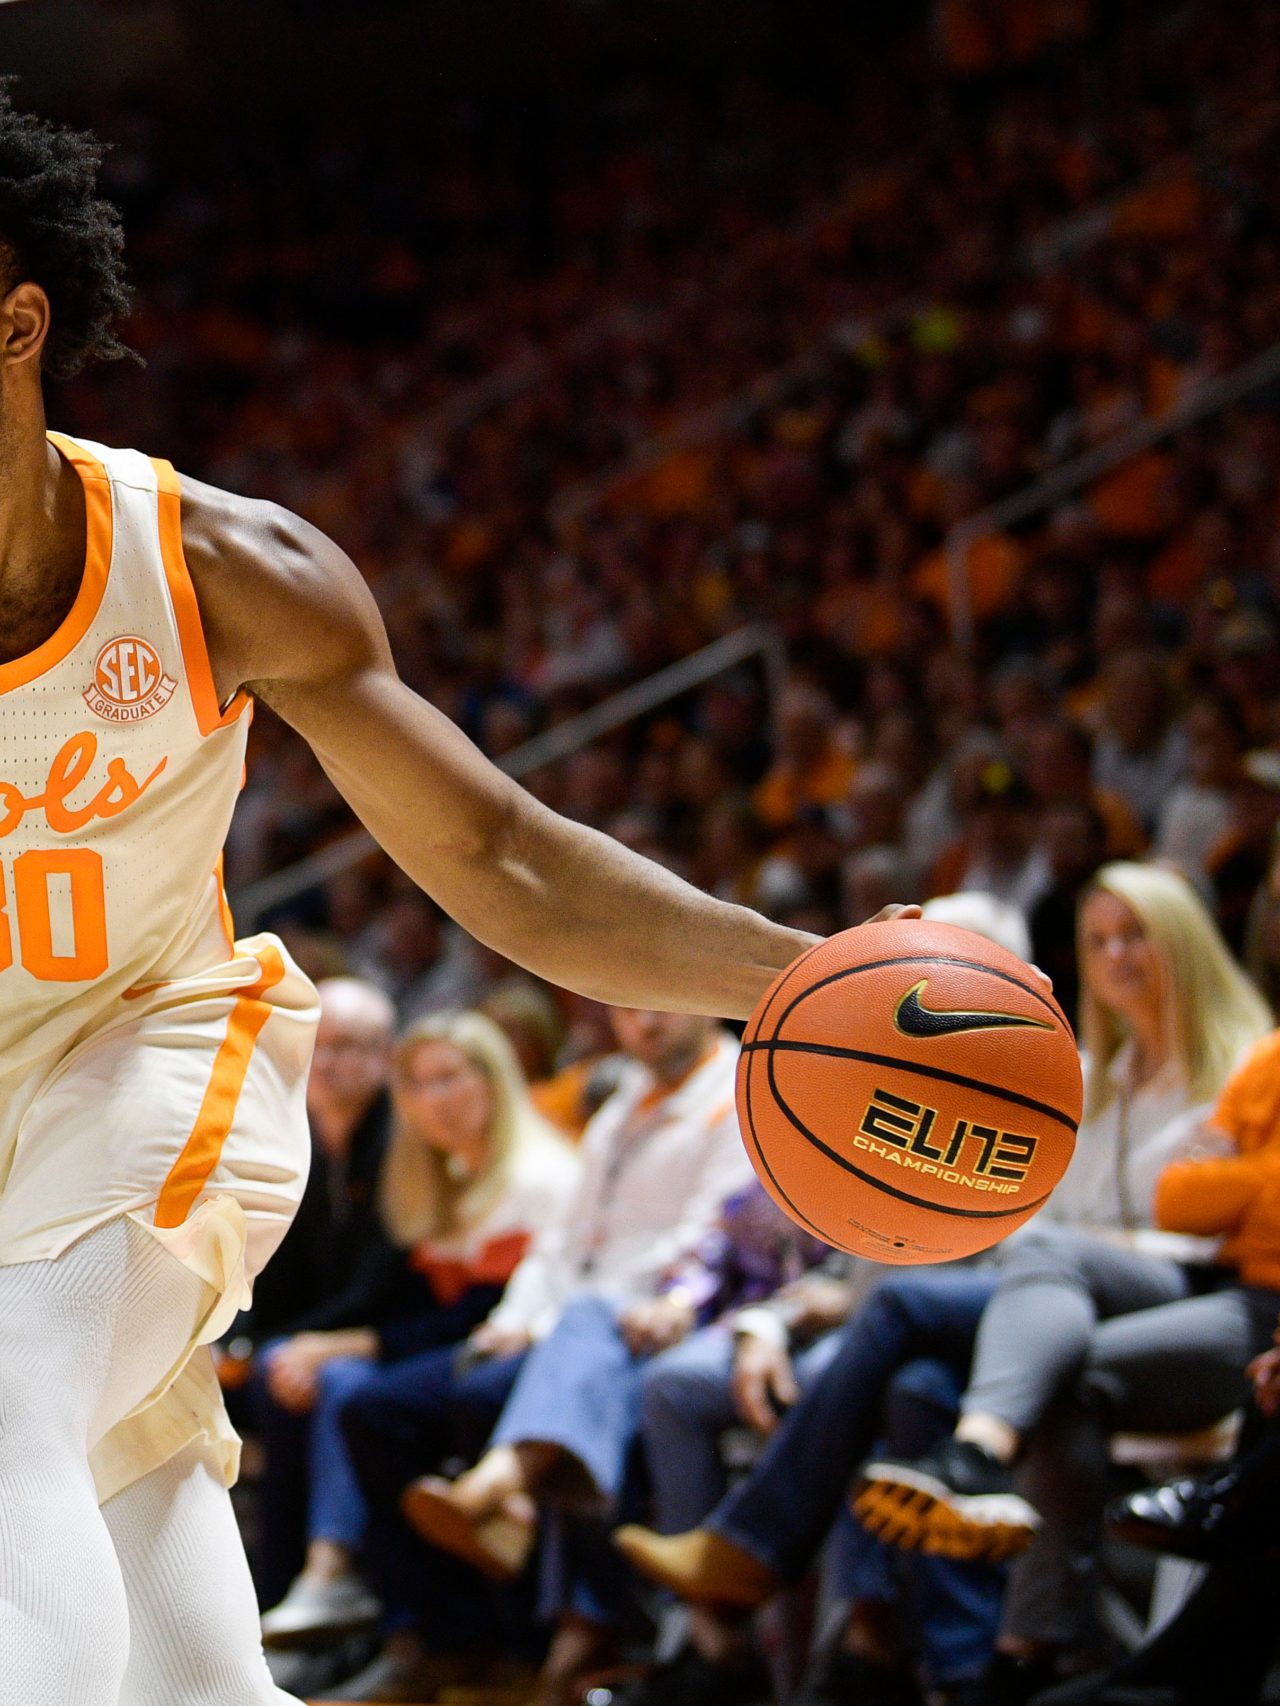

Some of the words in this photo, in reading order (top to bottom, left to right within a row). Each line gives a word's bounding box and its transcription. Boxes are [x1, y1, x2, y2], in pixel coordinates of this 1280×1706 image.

[99, 642, 155, 701] SEC
[94, 691, 166, 721] GRADUATE
[858, 1087, 1040, 1182] ELITE
[852, 1135, 1020, 1195] CHAMPIONSHIP
